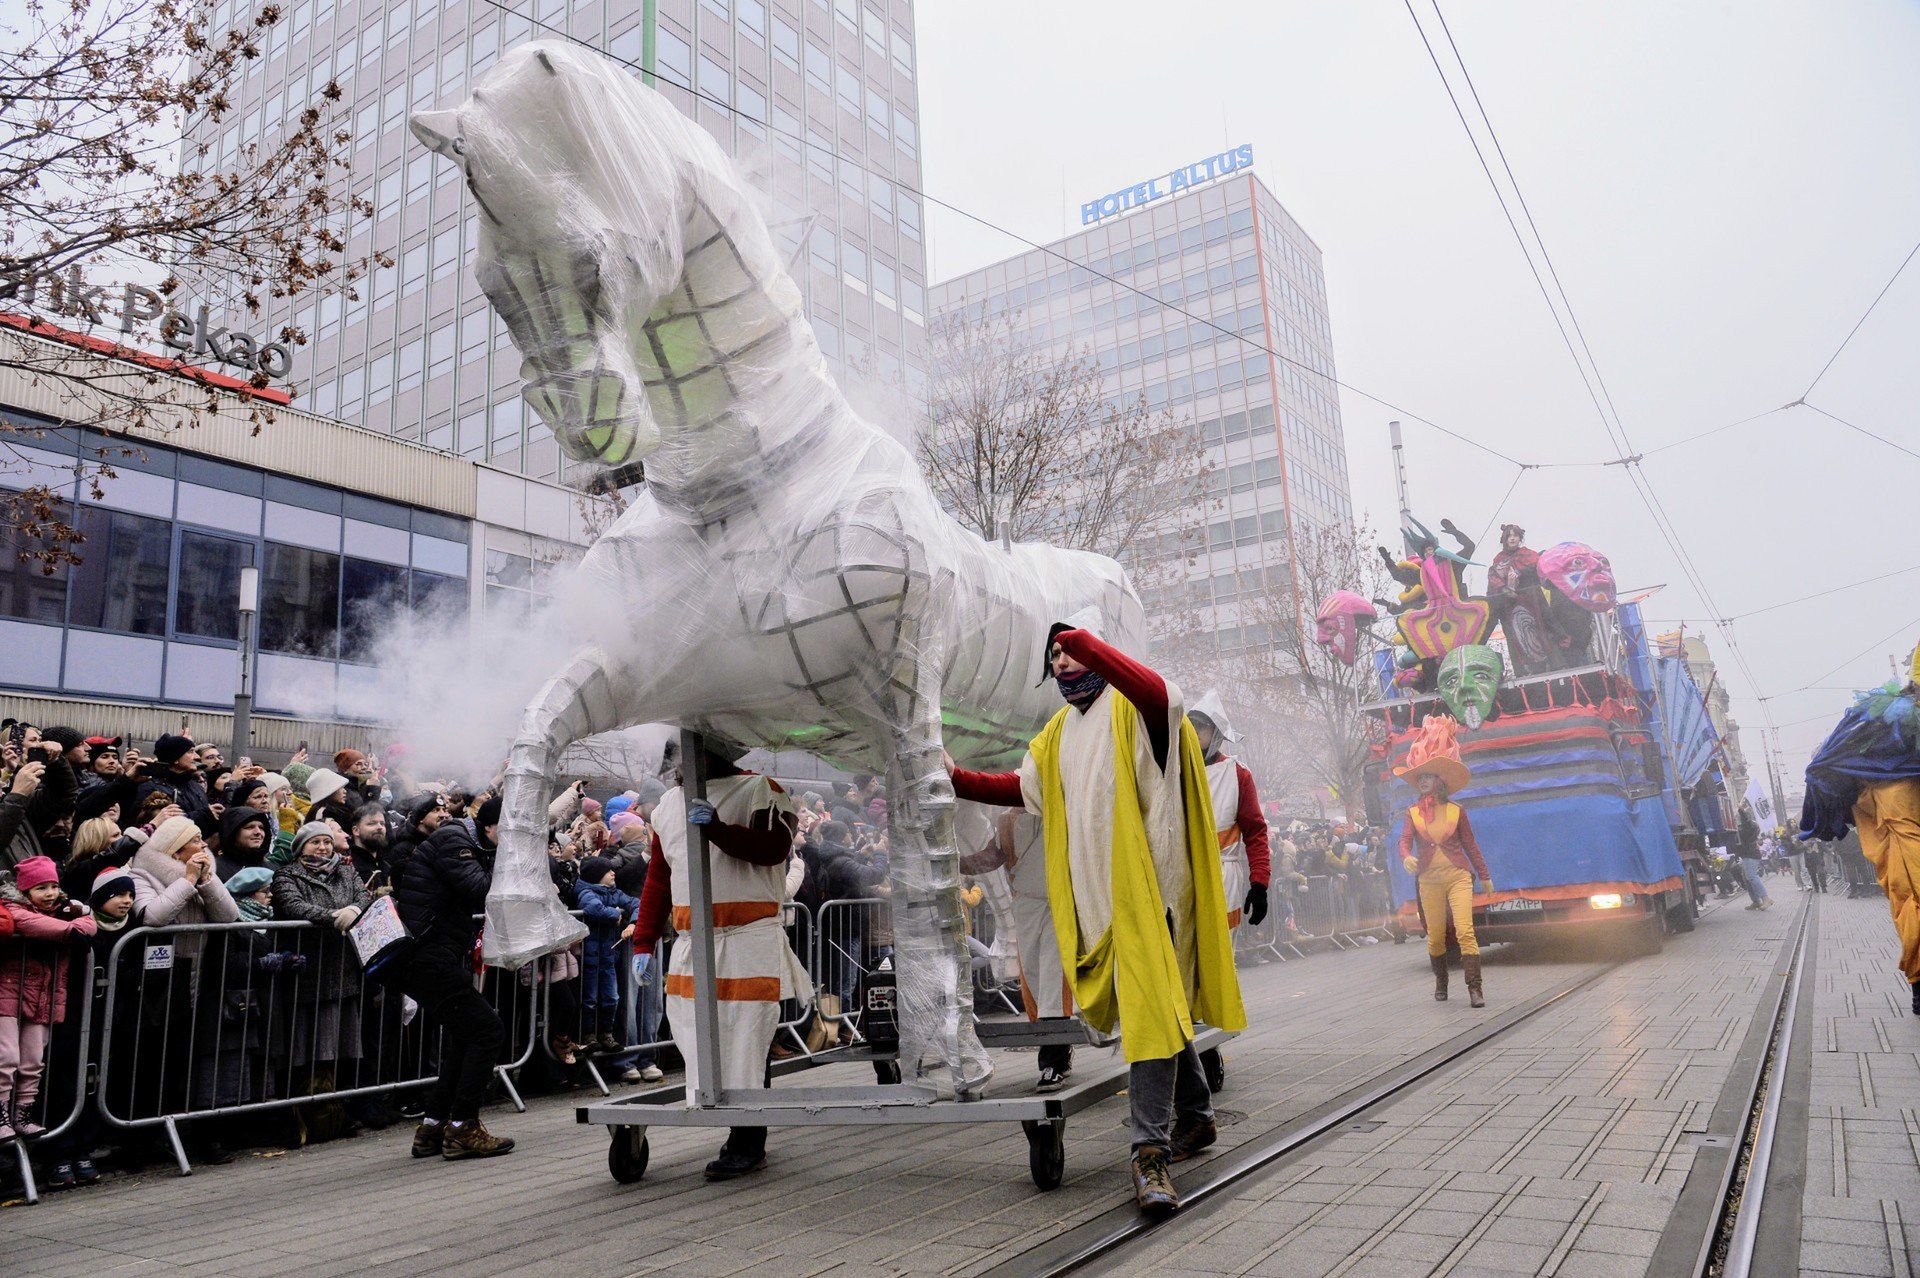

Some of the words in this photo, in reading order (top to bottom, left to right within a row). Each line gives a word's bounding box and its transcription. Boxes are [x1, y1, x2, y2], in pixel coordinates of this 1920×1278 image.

[1081, 179, 1163, 224] HOTEL
[1170, 143, 1253, 193] ALTUS
[120, 282, 293, 378] Pekao
